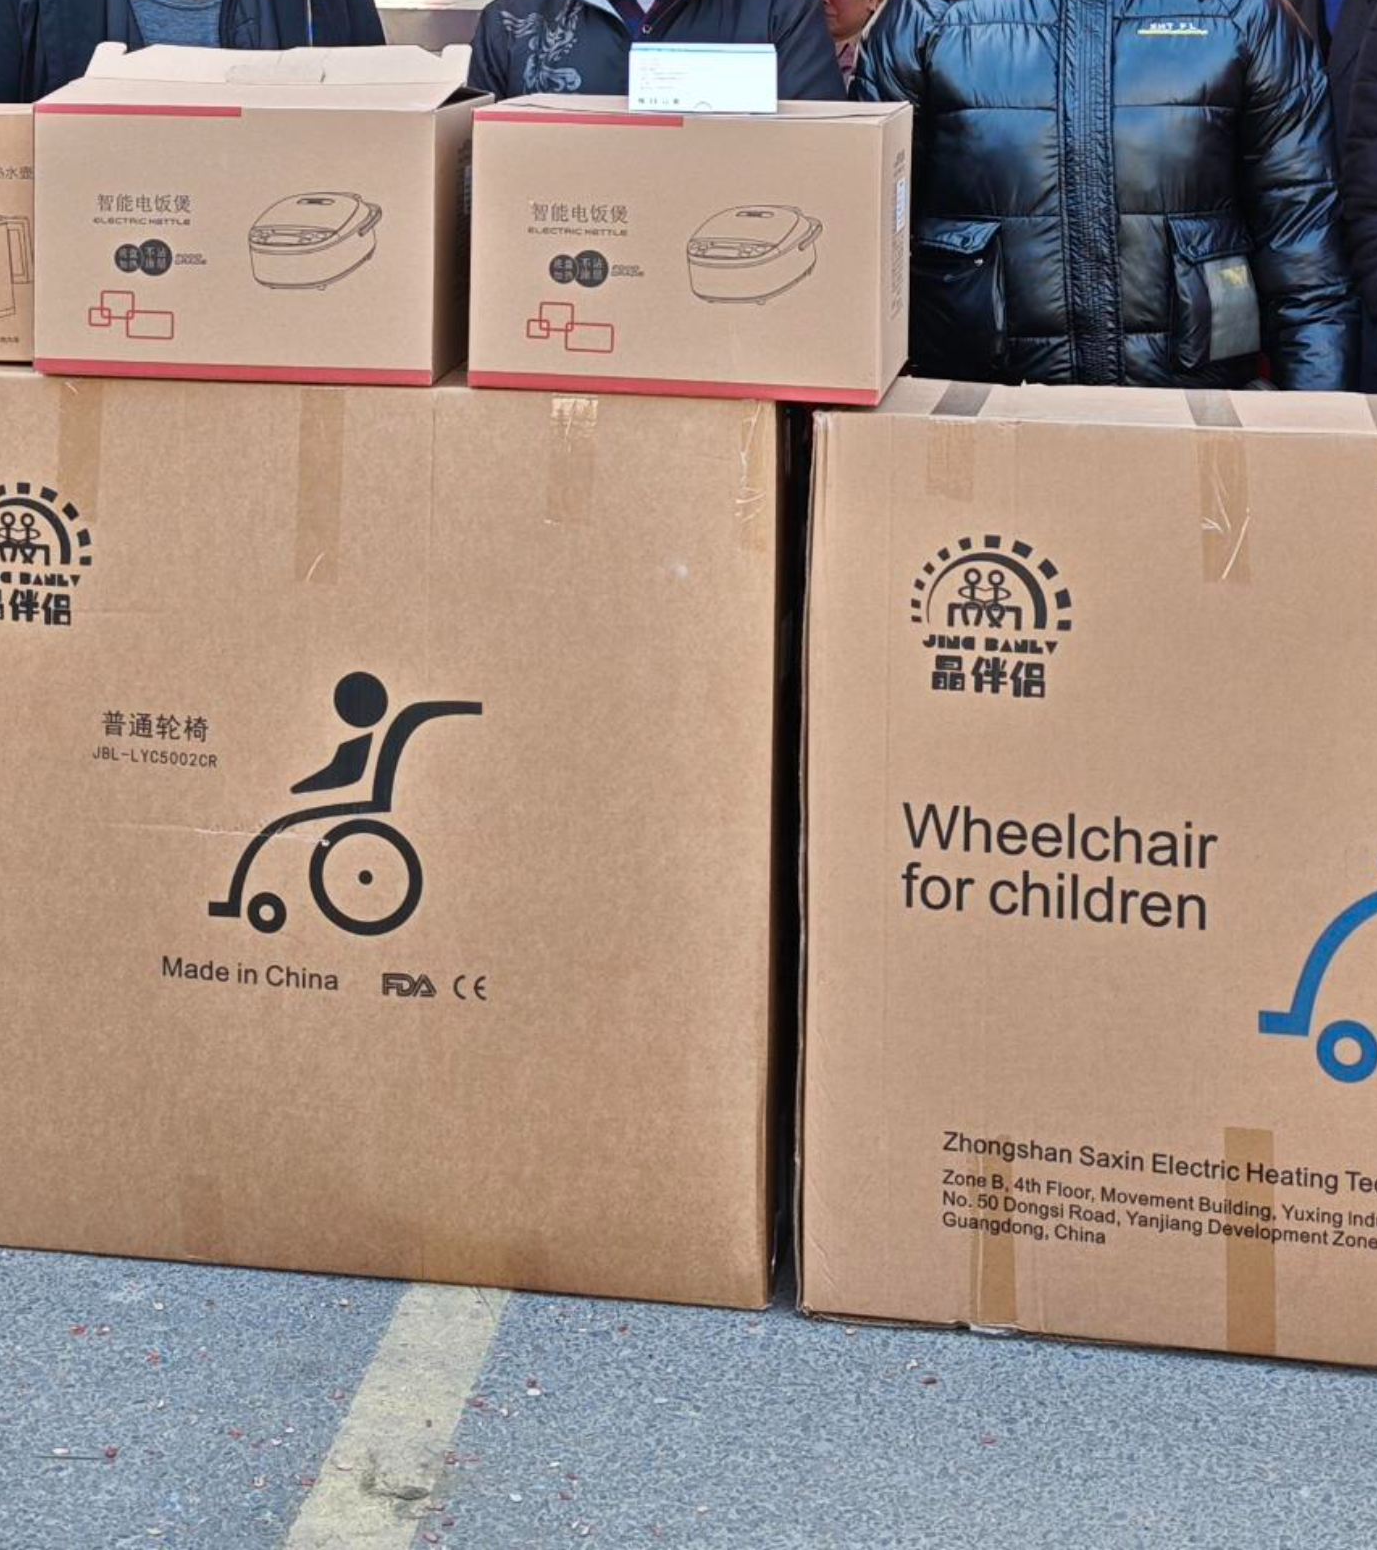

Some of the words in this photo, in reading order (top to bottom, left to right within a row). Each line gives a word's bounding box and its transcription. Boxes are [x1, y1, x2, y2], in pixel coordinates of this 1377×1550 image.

[92, 216, 147, 225] ELECTRIC
[97, 193, 191, 214] 智能电饭煲
[532, 202, 628, 224] 智能电饭煲
[931, 654, 1046, 698] 晶伴侣
[101, 710, 210, 743] 普通轮椅
[92, 745, 219, 768] JBL-LYC5002CR
[902, 801, 1219, 869] Wheelchair
[901, 861, 975, 912] for
[989, 869, 1206, 930] children
[161, 955, 229, 982] Made
[237, 962, 258, 985] in
[265, 964, 339, 991] China
[381, 972, 437, 998] FDA
[942, 1131, 1072, 1164] Zhongshan
[1079, 1145, 1144, 1172] Saxin
[1151, 1152, 1240, 1182] Electric
[1246, 1161, 1339, 1195] Heating
[942, 1169, 986, 1188] Zone
[991, 1174, 1010, 1193] B,
[1013, 1176, 1041, 1194] 4th
[1046, 1180, 1095, 1203] Floor,
[1100, 1186, 1194, 1212] Movement
[1198, 1196, 1277, 1222] Building,
[1281, 1203, 1343, 1228] Yuxing
[942, 1190, 972, 1209] No.
[977, 1194, 999, 1211] 50
[1003, 1196, 1064, 1219] Dongsi
[1069, 1204, 1121, 1227] Road,
[1126, 1210, 1203, 1236] Yanjiang
[1207, 1218, 1329, 1246] Development
[942, 1211, 1050, 1240] Guangdong,
[1054, 1223, 1106, 1244] China
